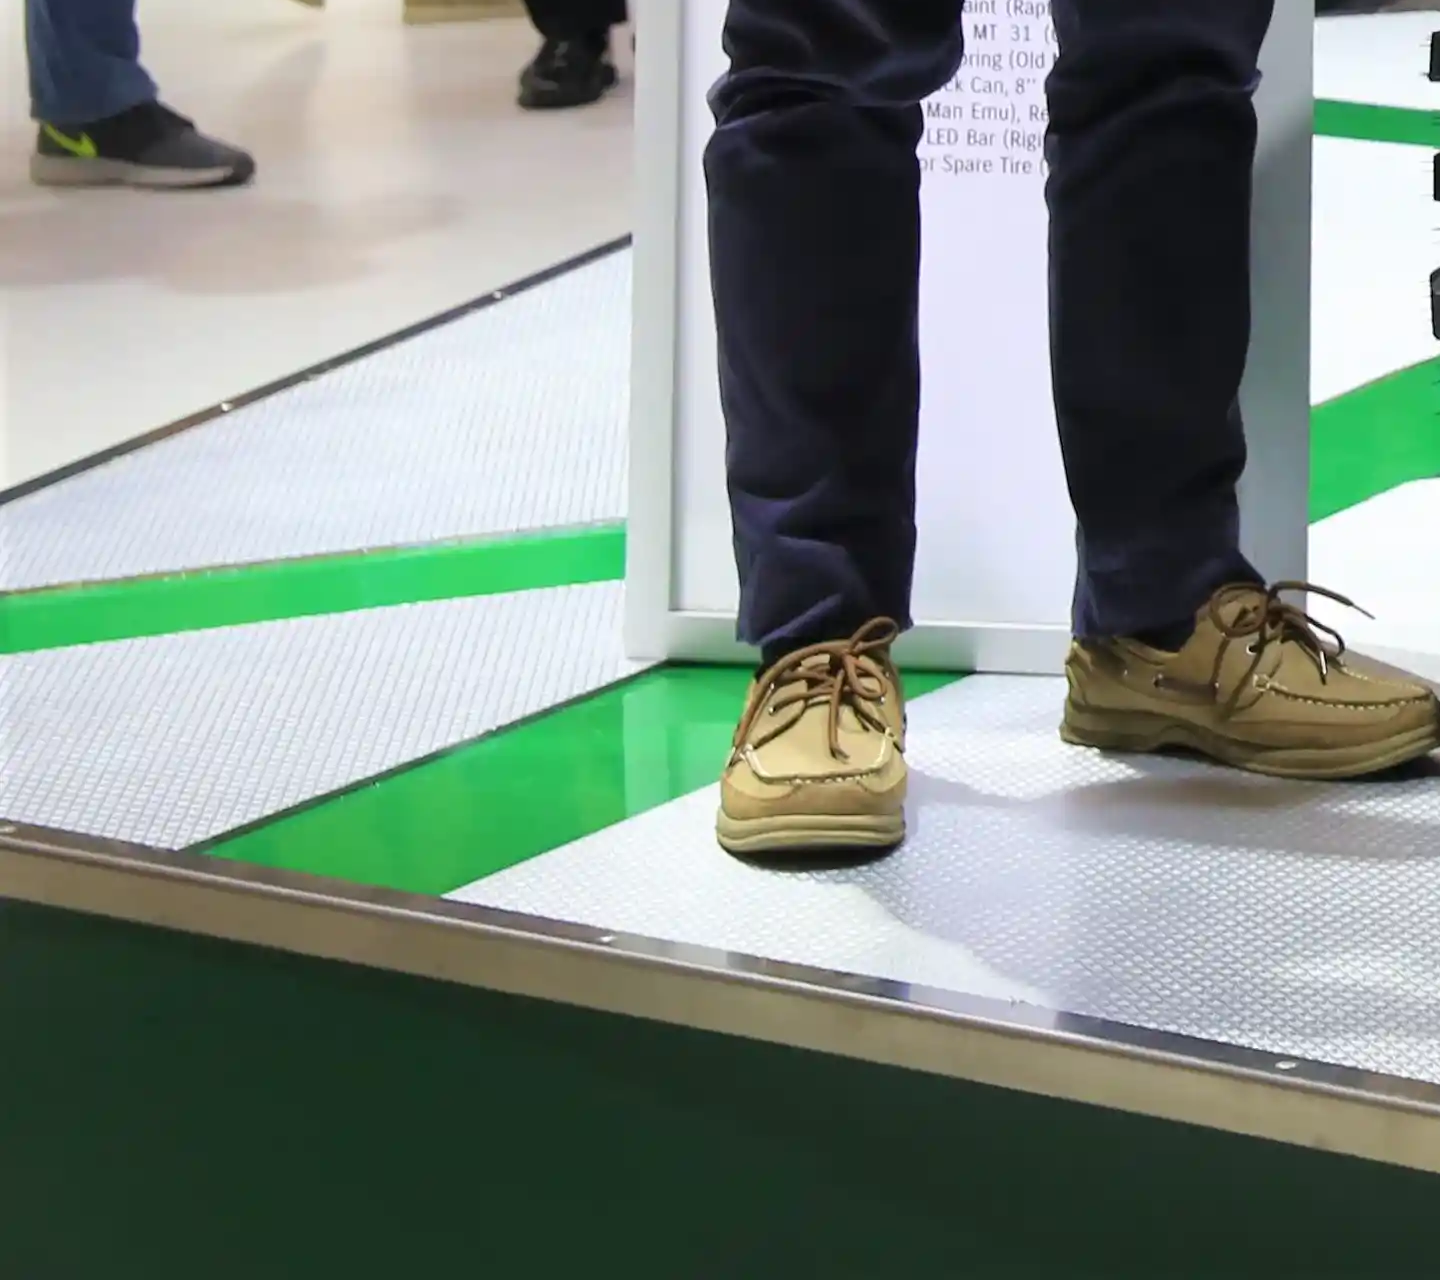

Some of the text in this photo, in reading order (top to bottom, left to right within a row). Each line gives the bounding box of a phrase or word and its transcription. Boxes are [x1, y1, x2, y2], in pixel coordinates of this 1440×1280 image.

[972, 24, 997, 42] MT
[1010, 24, 1031, 43] 31
[962, 48, 1045, 72] ring (Old
[970, 76, 1009, 98] Can,
[926, 101, 963, 120] Man
[1028, 104, 1050, 123] Re
[926, 128, 1043, 153] LED Bar (Rigi
[940, 154, 993, 176] Spare
[1000, 156, 1033, 175] Tire
